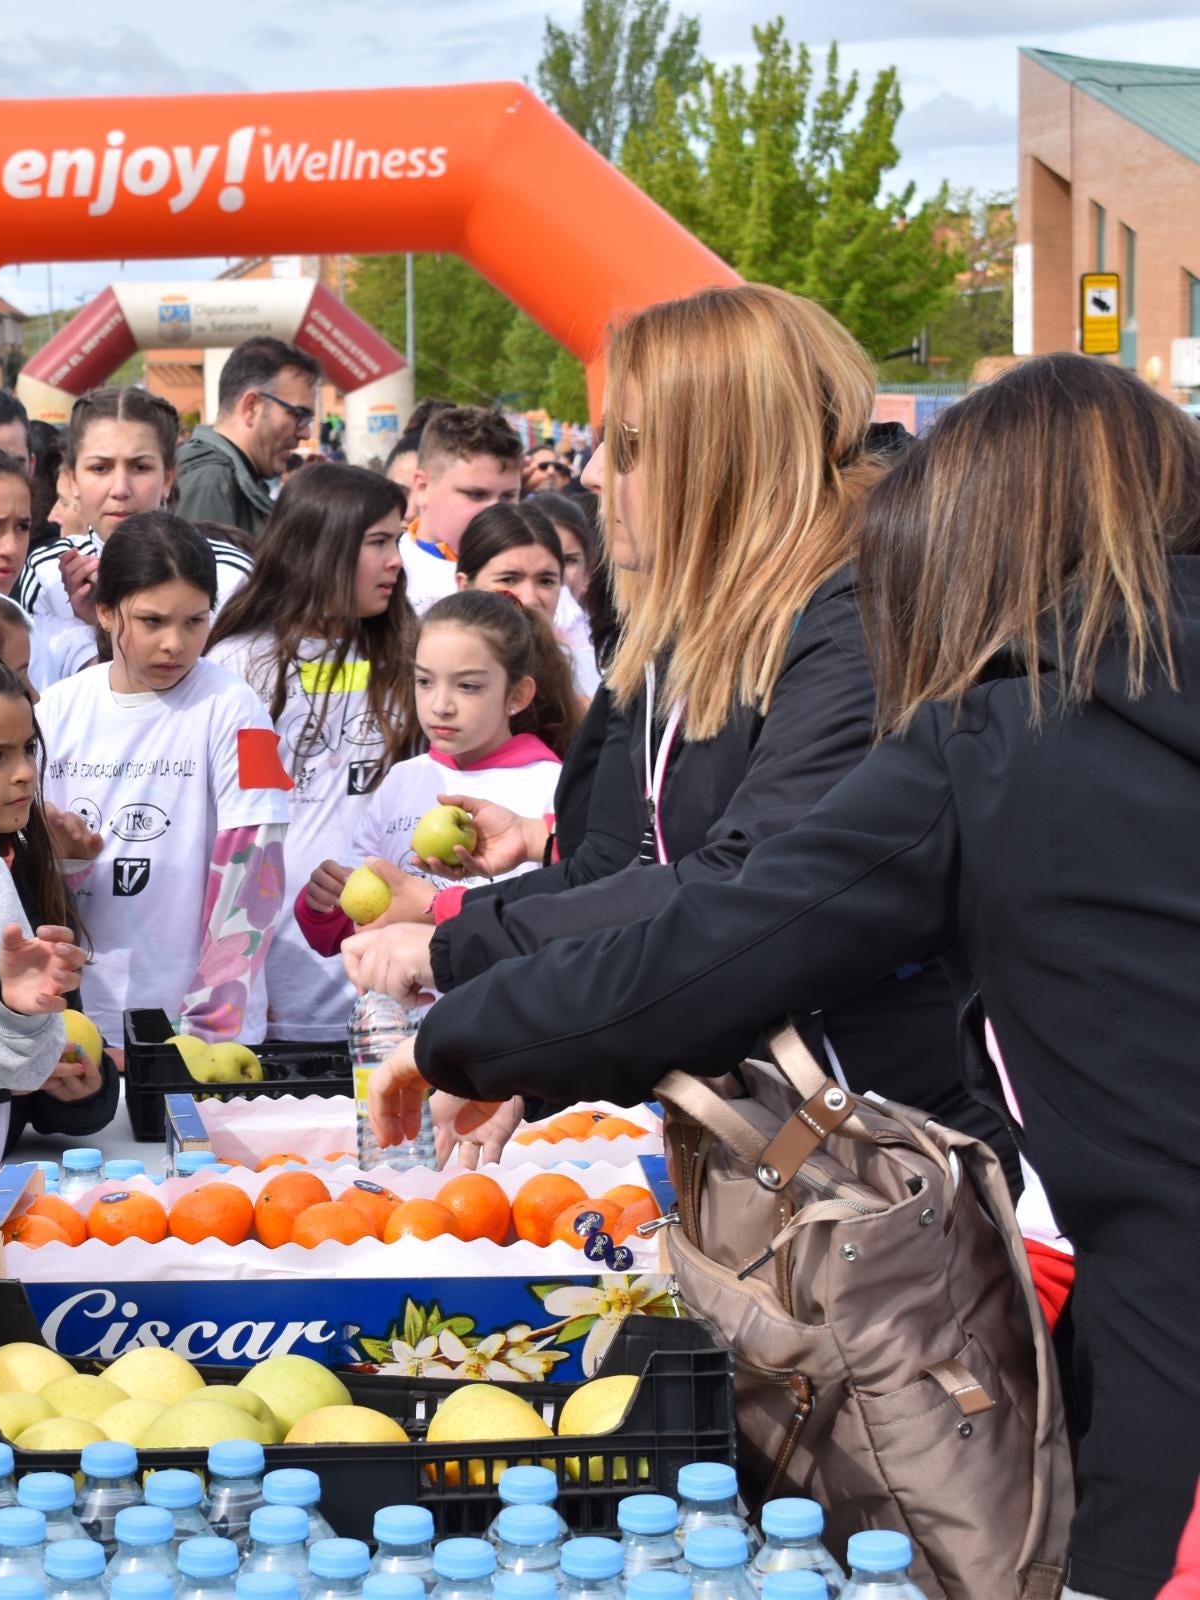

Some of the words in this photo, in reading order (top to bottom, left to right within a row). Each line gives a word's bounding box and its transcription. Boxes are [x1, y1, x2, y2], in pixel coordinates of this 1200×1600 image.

[1, 126, 256, 217] enjoy!
[262, 139, 448, 183] Wellness
[40, 1288, 337, 1360] Ciscar
